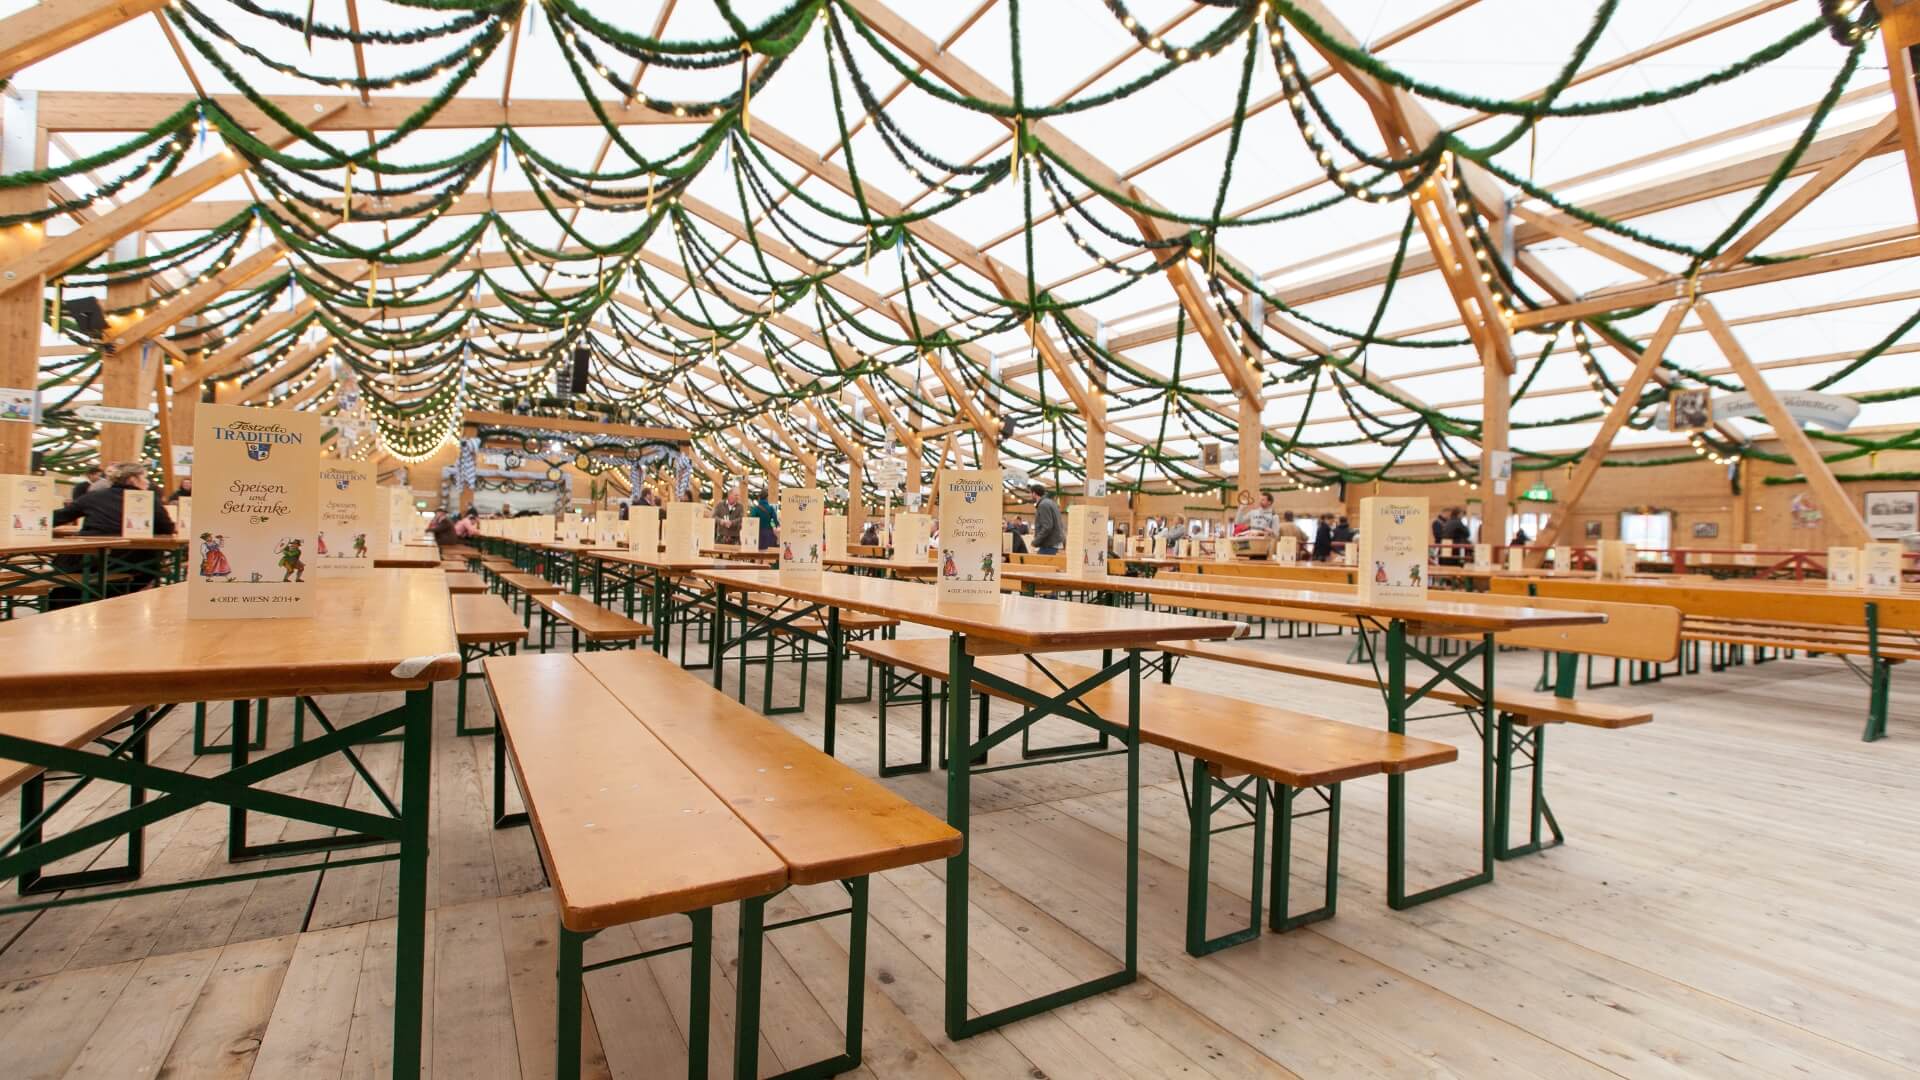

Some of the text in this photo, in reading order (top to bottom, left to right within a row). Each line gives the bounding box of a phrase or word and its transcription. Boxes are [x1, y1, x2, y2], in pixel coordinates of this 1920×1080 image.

[228, 420, 287, 433] Festzelt
[212, 426, 303, 444] TRADITION
[229, 479, 288, 496] Speisen
[949, 483, 994, 492] TRADITION
[248, 493, 268, 501] und
[220, 500, 292, 516] Getränke
[242, 595, 270, 603] WIESN
[271, 595, 292, 603] 2014
